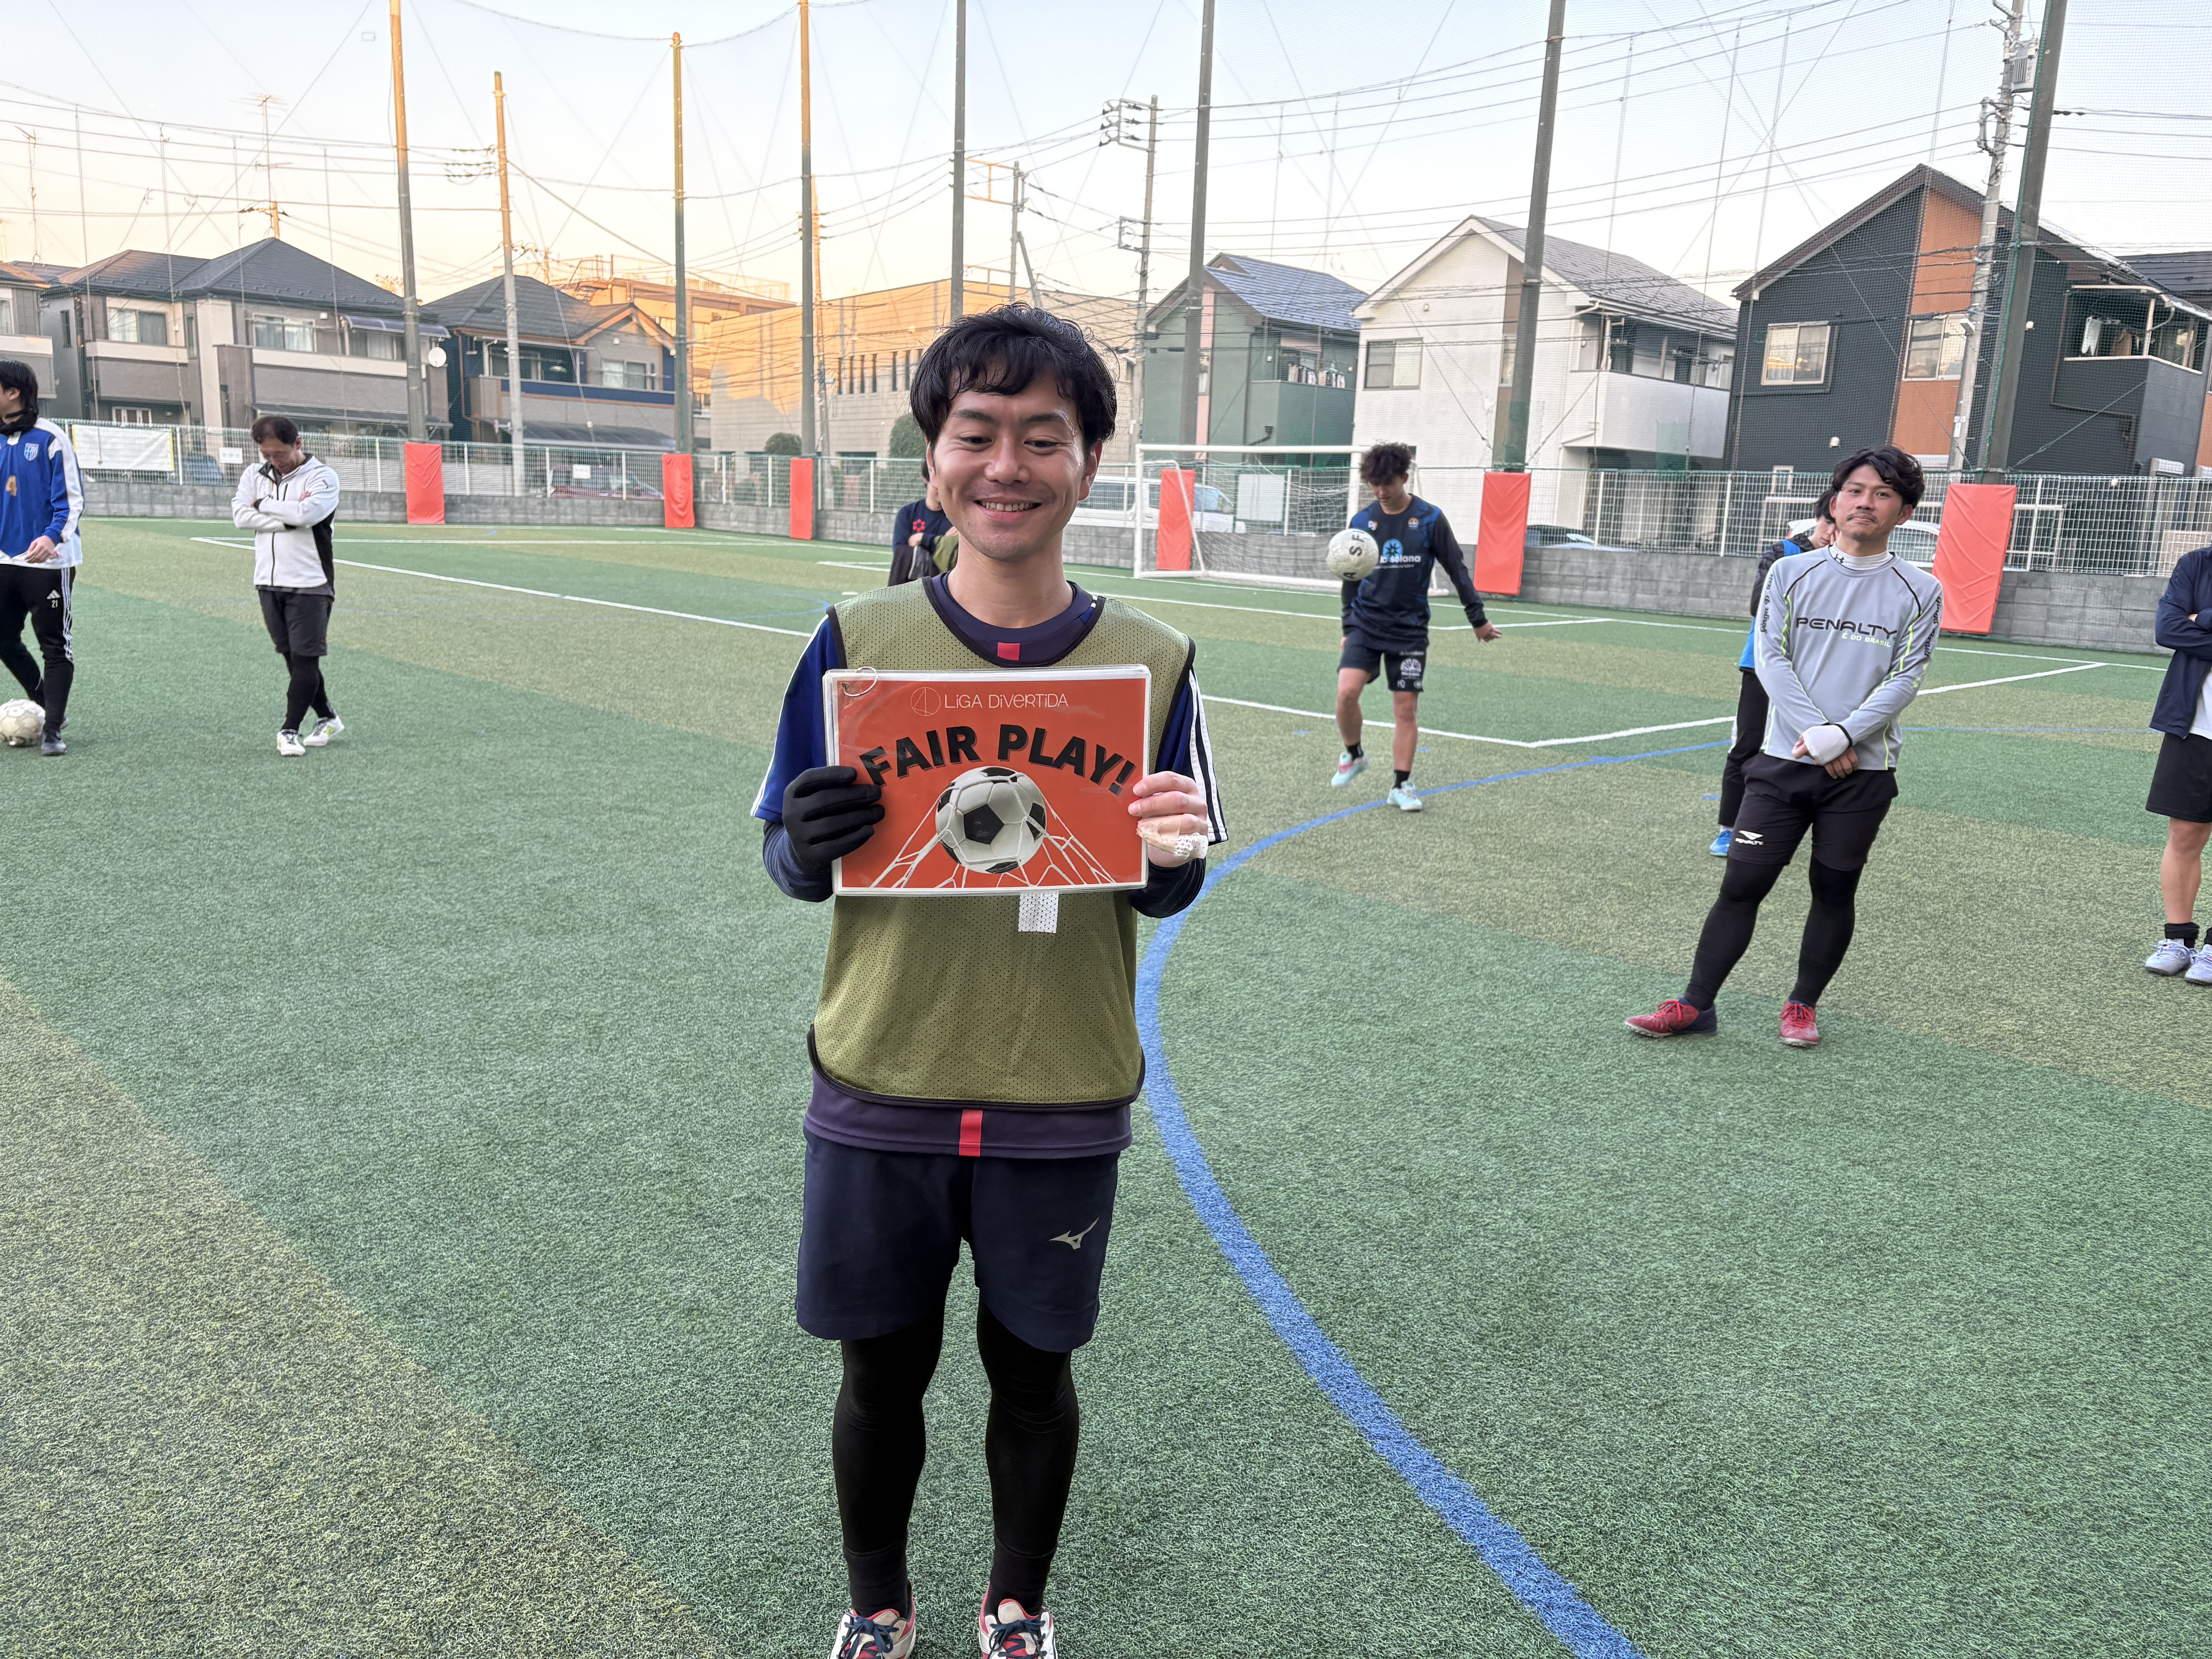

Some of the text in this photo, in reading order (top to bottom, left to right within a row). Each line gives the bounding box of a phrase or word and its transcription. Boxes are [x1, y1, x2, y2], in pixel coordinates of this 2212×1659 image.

[1389, 554, 1421, 563] solana
[52, 599, 58, 608] 21
[1796, 617, 1897, 640] PENALTY
[1865, 637, 1891, 648] BRASIL
[859, 724, 1136, 795] FAIR PLAY!
